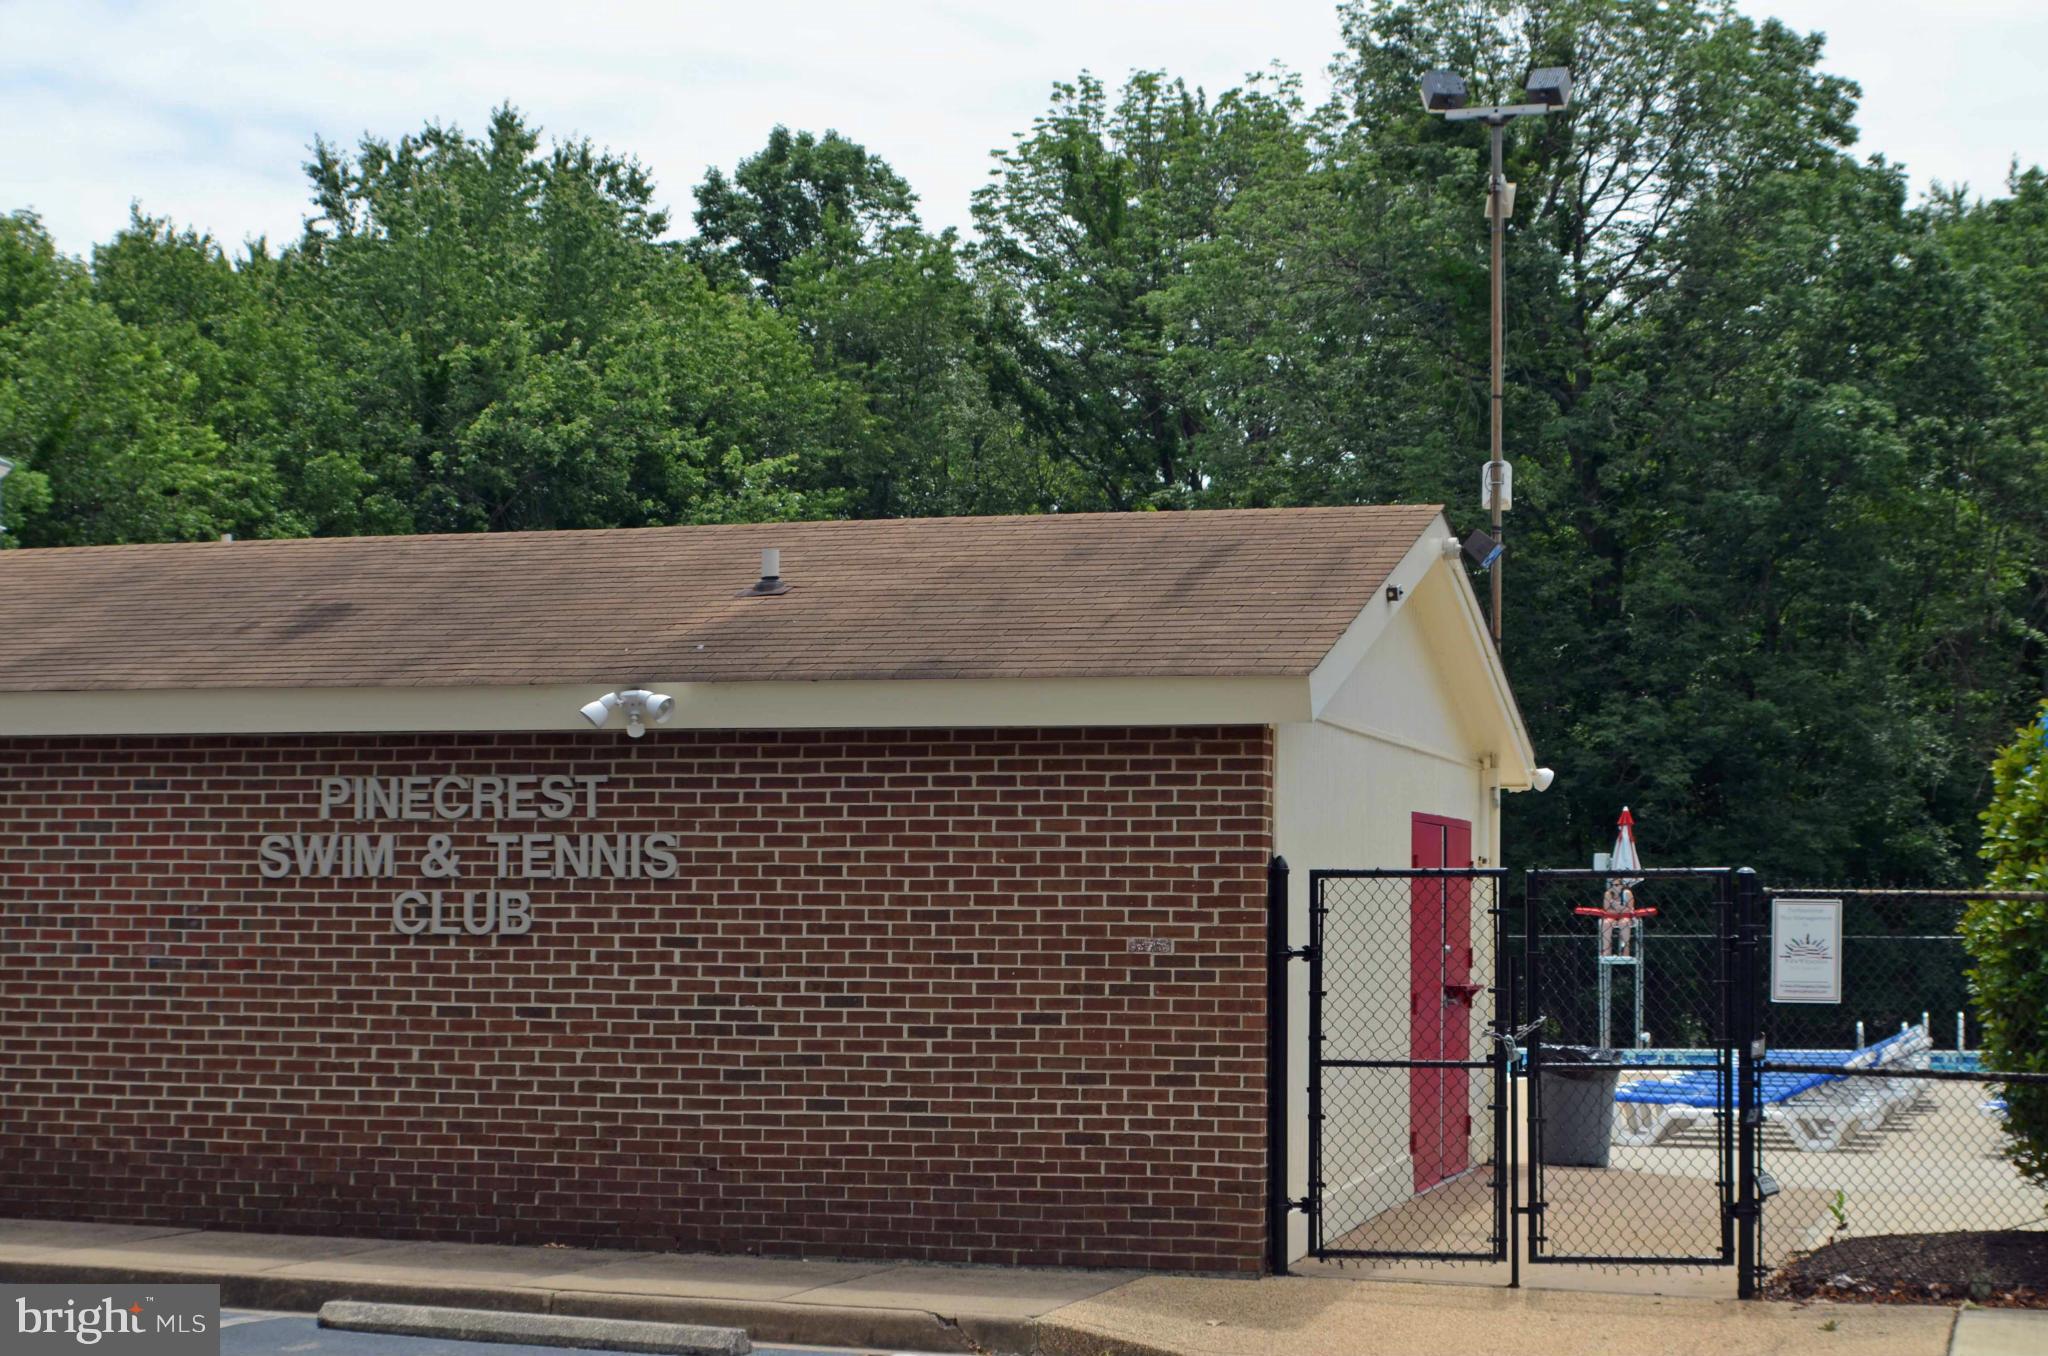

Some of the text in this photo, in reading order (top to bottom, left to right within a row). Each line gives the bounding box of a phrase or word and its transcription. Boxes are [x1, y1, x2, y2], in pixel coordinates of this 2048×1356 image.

[320, 774, 608, 820] PINECREST
[259, 832, 678, 879] SWIM & TENNIS
[392, 889, 532, 936] CLUB
